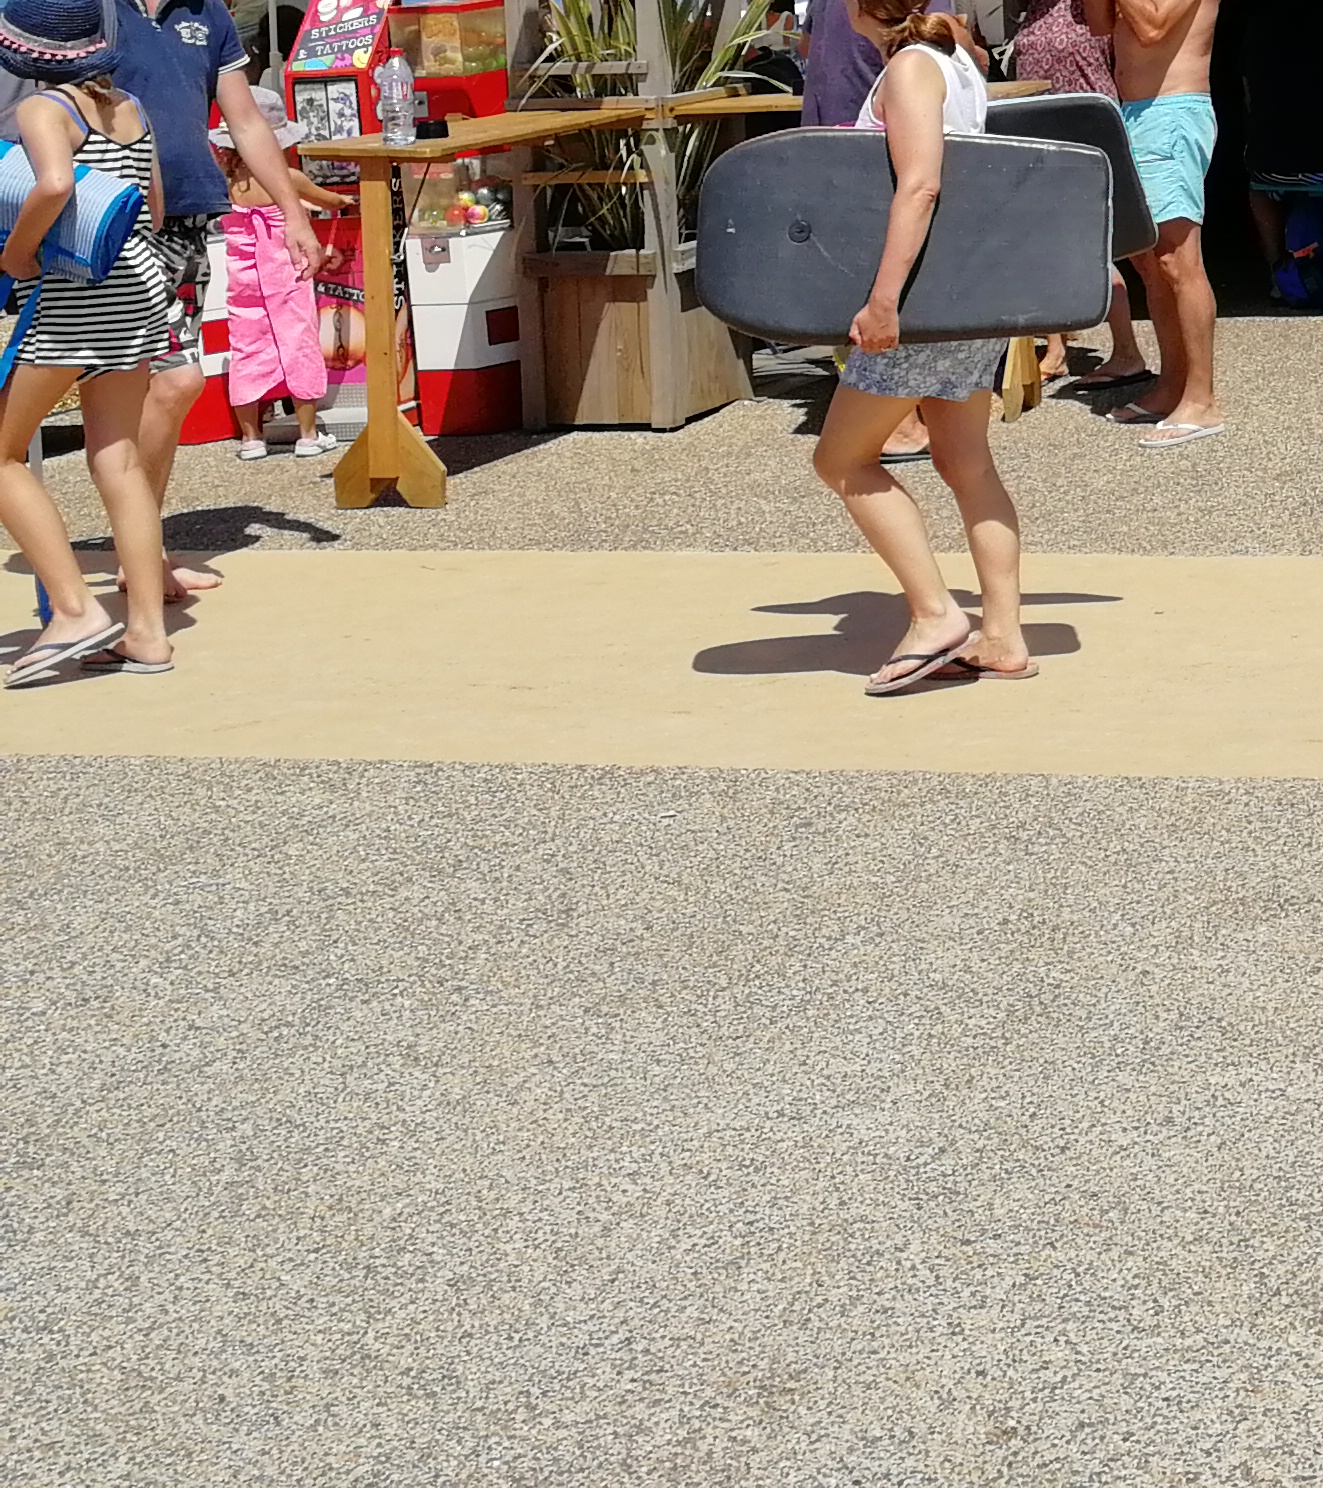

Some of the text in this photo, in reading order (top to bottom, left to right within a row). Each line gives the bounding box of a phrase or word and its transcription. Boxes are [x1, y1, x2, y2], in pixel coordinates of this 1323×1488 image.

[310, 15, 377, 40] STICKERS
[316, 35, 373, 56] TATTOOS
[391, 177, 407, 311] STIKERS
